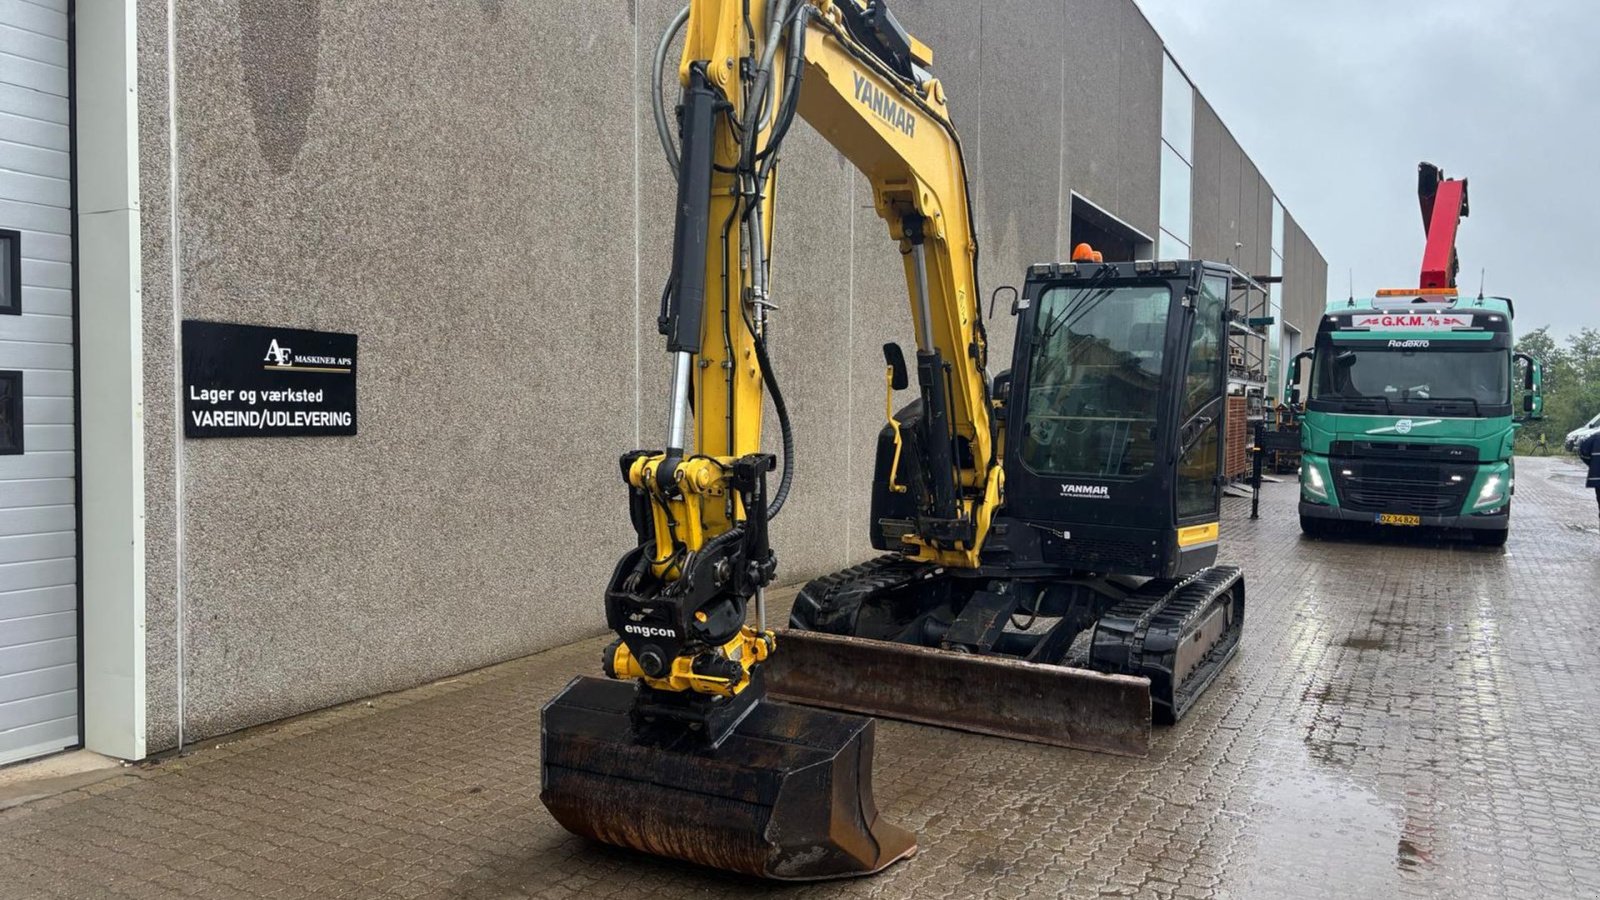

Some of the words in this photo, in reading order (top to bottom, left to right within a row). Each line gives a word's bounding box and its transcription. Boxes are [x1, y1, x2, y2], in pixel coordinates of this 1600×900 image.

[853, 70, 915, 138] YANMAR
[1381, 316, 1425, 326] G.K.M.
[294, 355, 336, 365] MASKINER
[337, 357, 352, 366] APS
[190, 385, 234, 404] Lager
[239, 390, 257, 405] og
[260, 388, 323, 402] værksted
[192, 409, 352, 429] VAREIND/UDLEVERING
[1061, 484, 1108, 494] YANMAR
[624, 624, 676, 638] engcon
